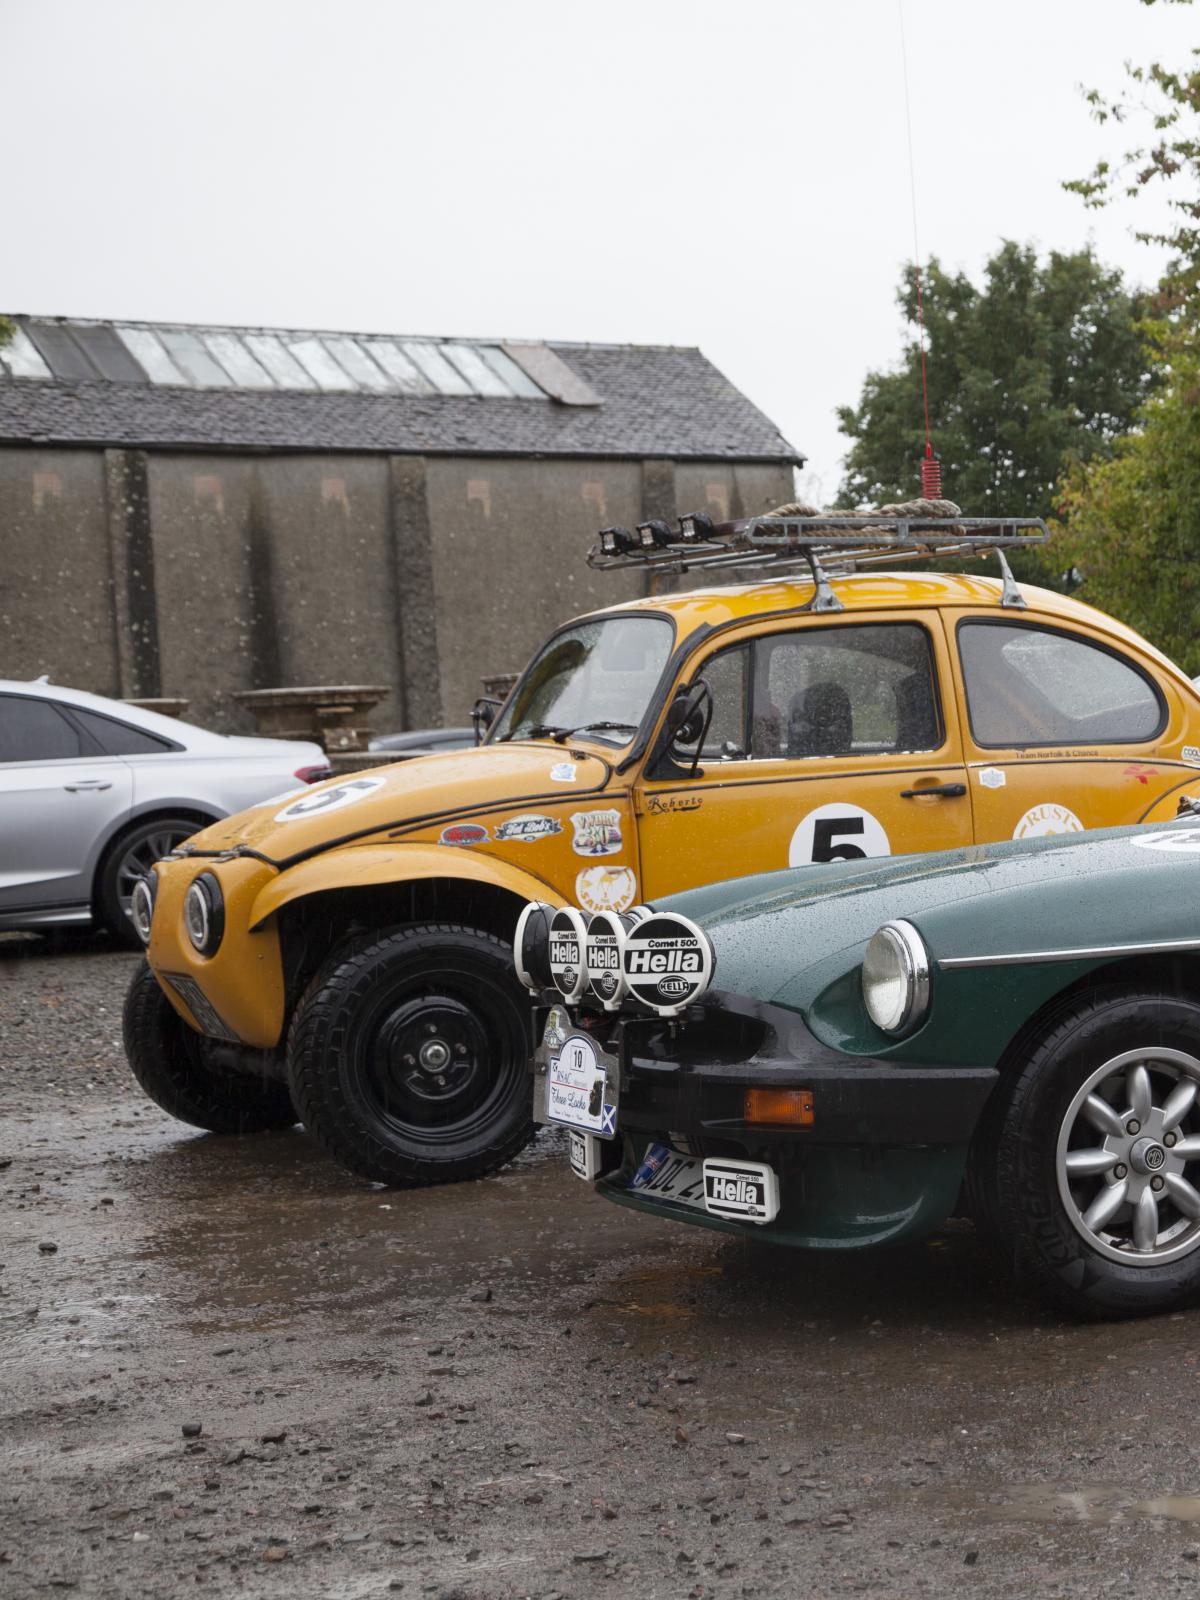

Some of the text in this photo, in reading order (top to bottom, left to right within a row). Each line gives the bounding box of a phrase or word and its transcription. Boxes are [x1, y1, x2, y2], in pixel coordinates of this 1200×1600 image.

[286, 781, 378, 815] 5
[1025, 805, 1072, 827] RUST
[551, 942, 579, 963] Hella
[648, 938, 698, 949] Comet 500
[588, 946, 618, 969] Hella
[629, 950, 700, 974] Hella
[659, 980, 690, 991] HELLA
[573, 1050, 583, 1068] 10
[713, 1177, 757, 1204] Hella
